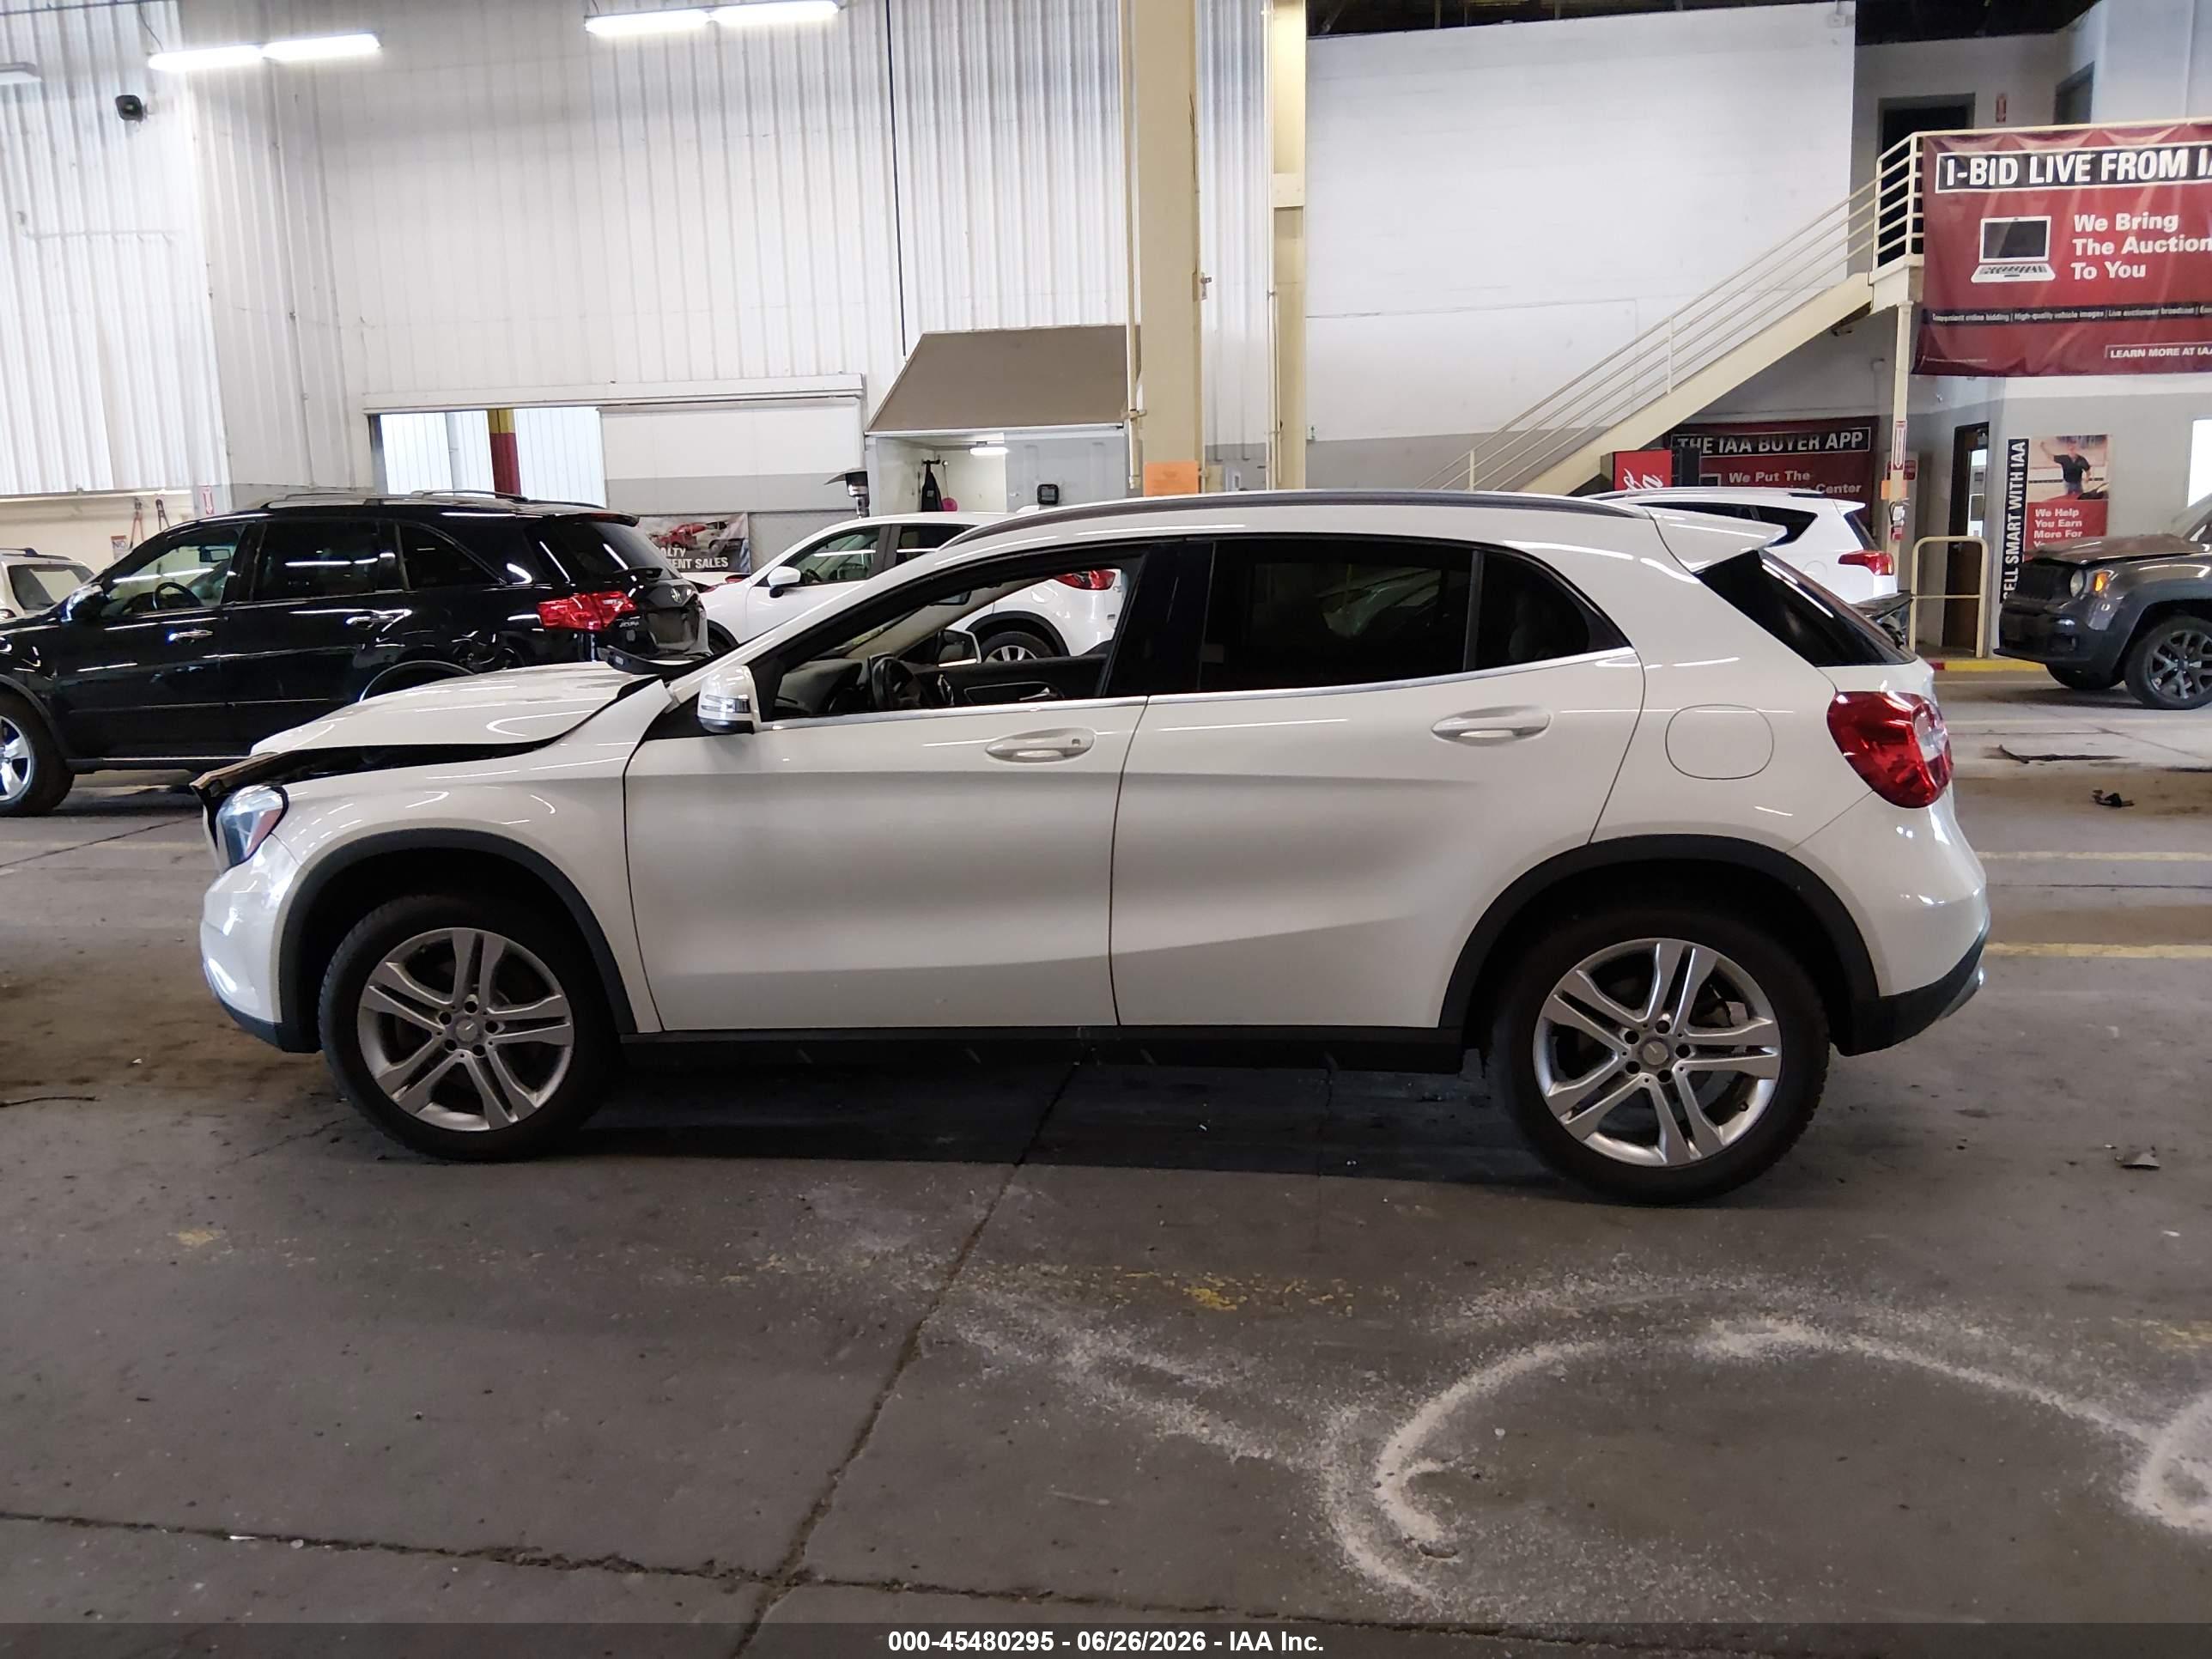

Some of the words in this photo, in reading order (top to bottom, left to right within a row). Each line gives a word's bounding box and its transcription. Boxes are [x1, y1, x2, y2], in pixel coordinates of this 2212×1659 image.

[1946, 157, 2018, 186] I-BID
[2029, 154, 2094, 185] LIVE
[2100, 149, 2188, 181] FROM
[2073, 215, 2108, 233] We
[2116, 212, 2179, 233] Bring
[2072, 238, 2114, 257] The
[2121, 234, 2212, 254] Auction
[2070, 263, 2097, 281] To
[2105, 260, 2146, 278] You
[2110, 349, 2146, 358] LEARN
[2148, 348, 2179, 356] MORE
[2182, 347, 2196, 356] AT
[1719, 435, 1752, 453] IAA
[1759, 434, 1820, 452] BUYER
[1825, 432, 1863, 449] APP
[2010, 441, 2026, 467] IAA
[1729, 472, 1750, 483] We
[1755, 471, 1779, 482] Put
[1784, 471, 1810, 481] The
[1816, 483, 1862, 494] Center
[2008, 471, 2024, 510] WITH
[2035, 508, 2052, 517] We
[2054, 507, 2080, 518] Help
[2033, 530, 2062, 538] More
[2064, 529, 2083, 538] For
[2034, 520, 2055, 528] You
[2057, 519, 2082, 527] Earn
[2005, 514, 2021, 564] SMART
[696, 556, 729, 568] SALES
